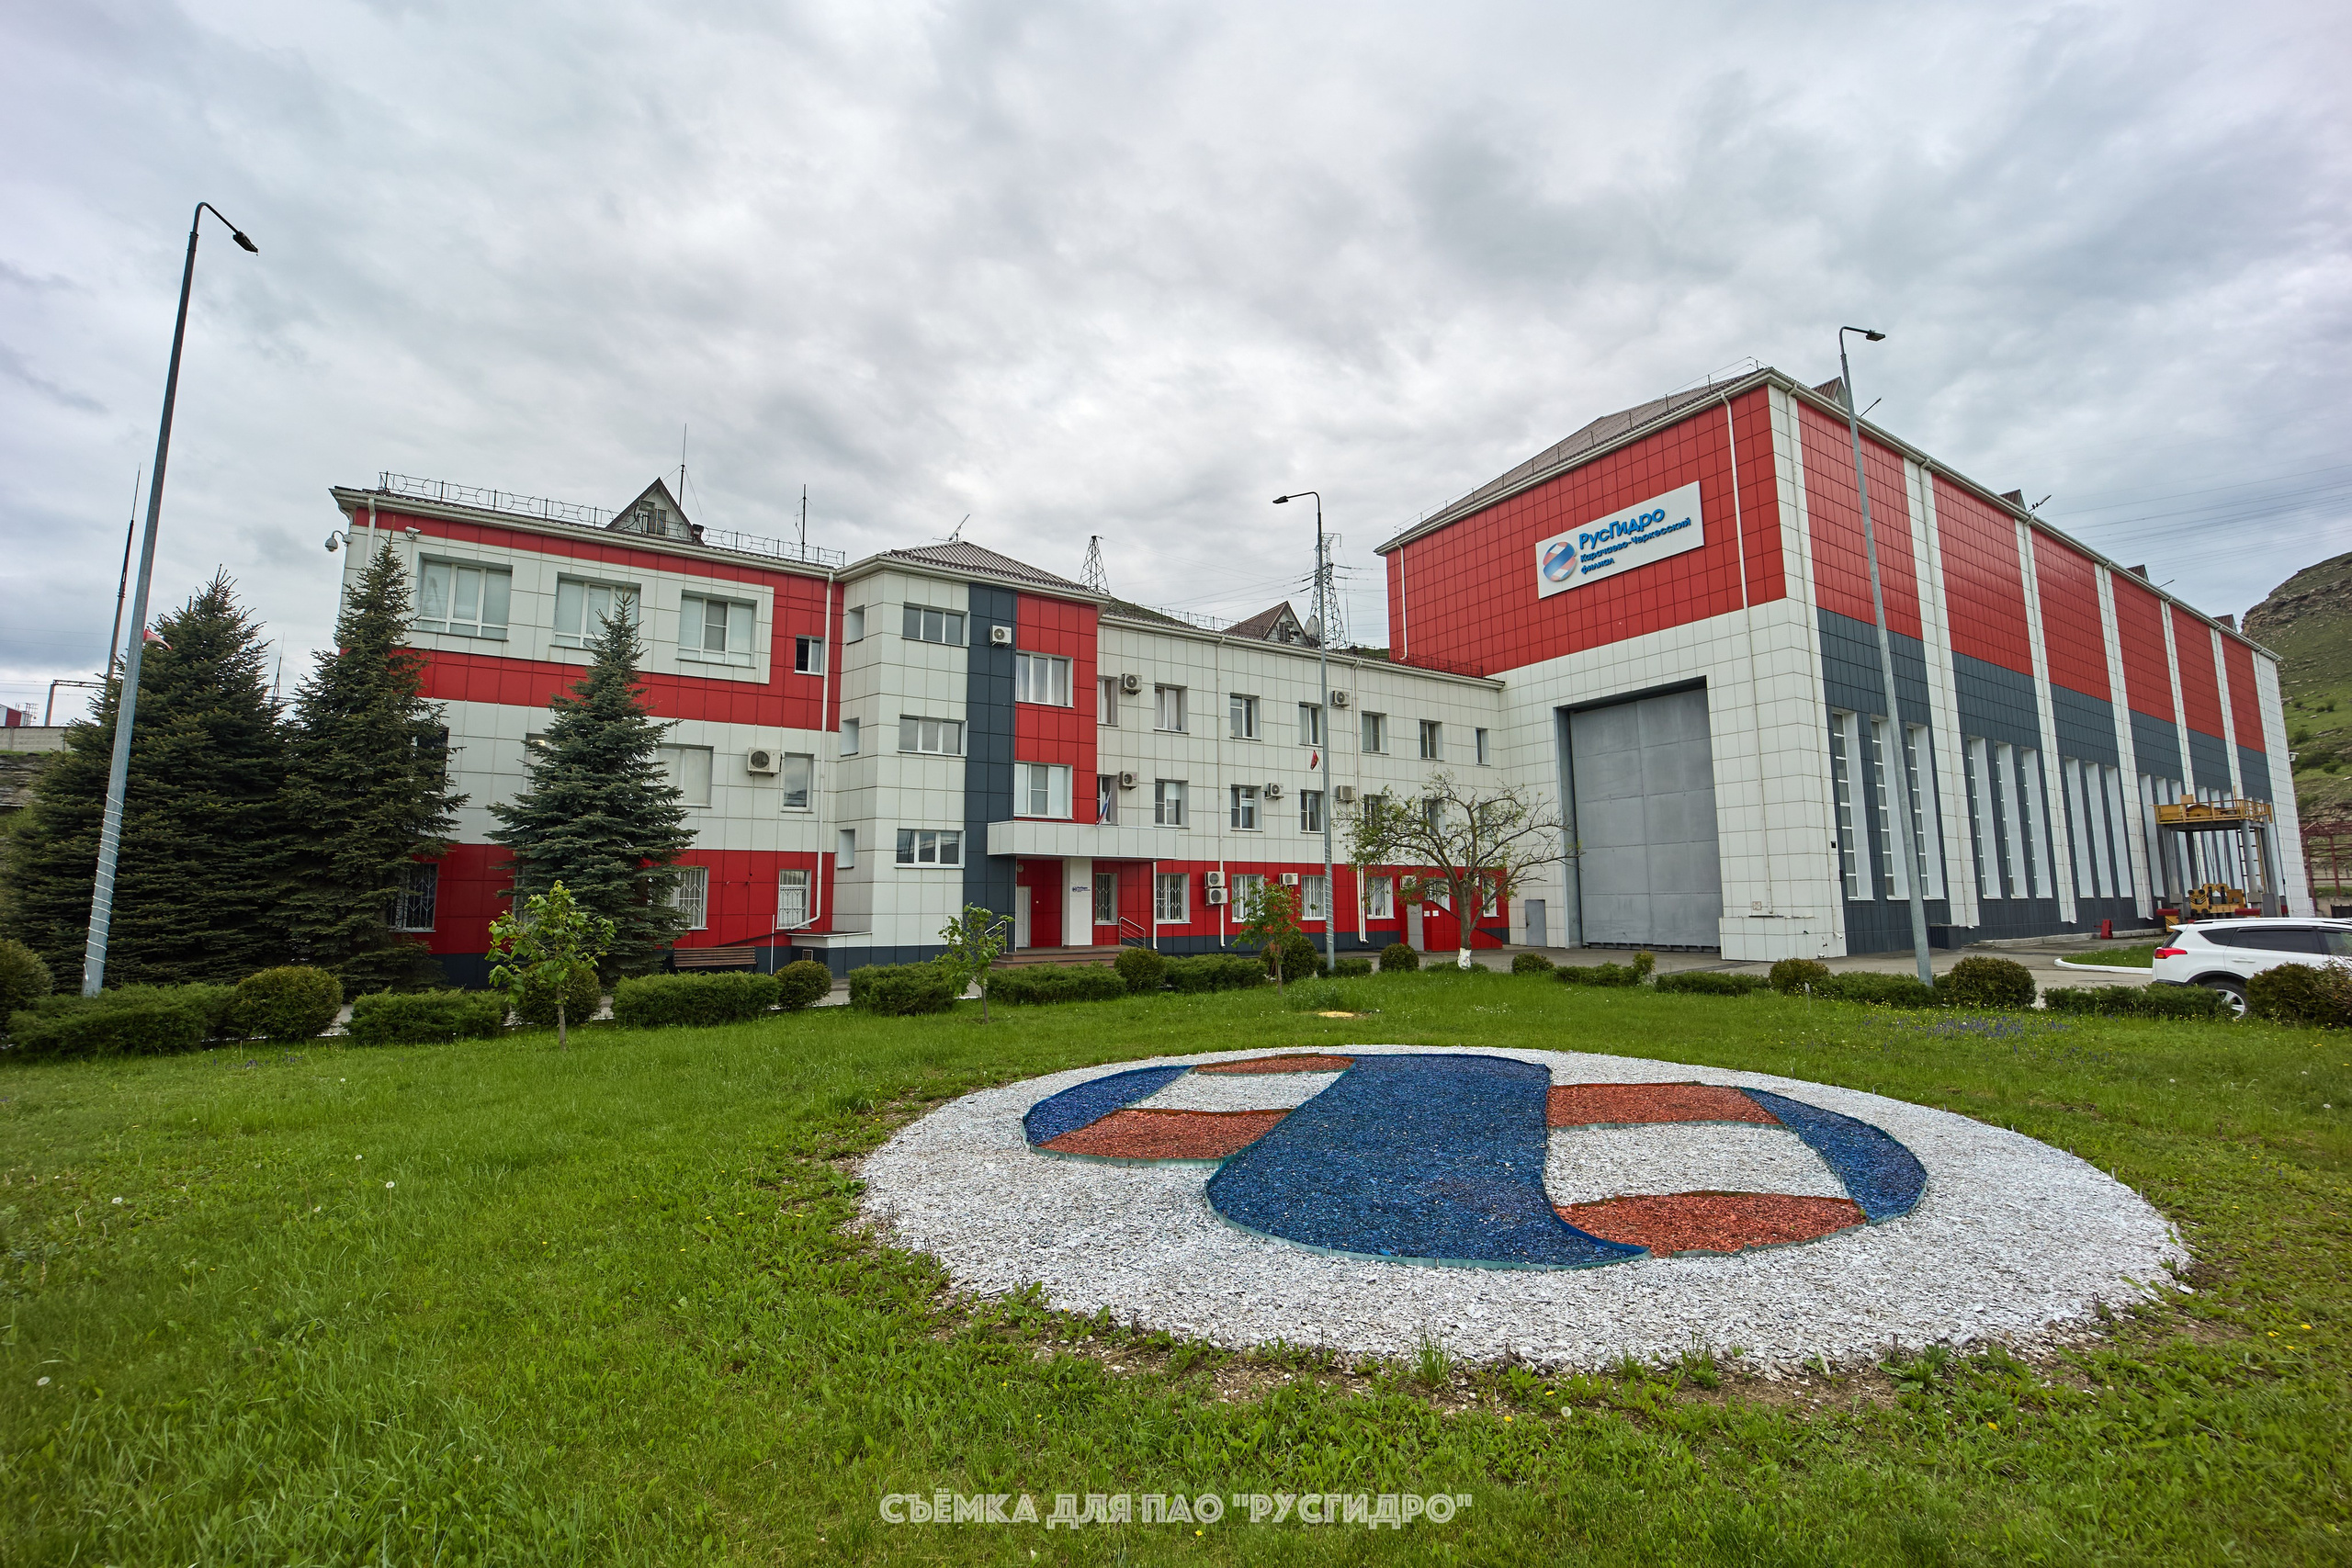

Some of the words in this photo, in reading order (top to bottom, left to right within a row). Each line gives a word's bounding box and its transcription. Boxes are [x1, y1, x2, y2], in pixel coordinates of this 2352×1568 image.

[1579, 508, 1666, 549] РусГидро
[1579, 517, 1691, 563] Карачаево-Черкесский
[1580, 557, 1615, 575] филиал
